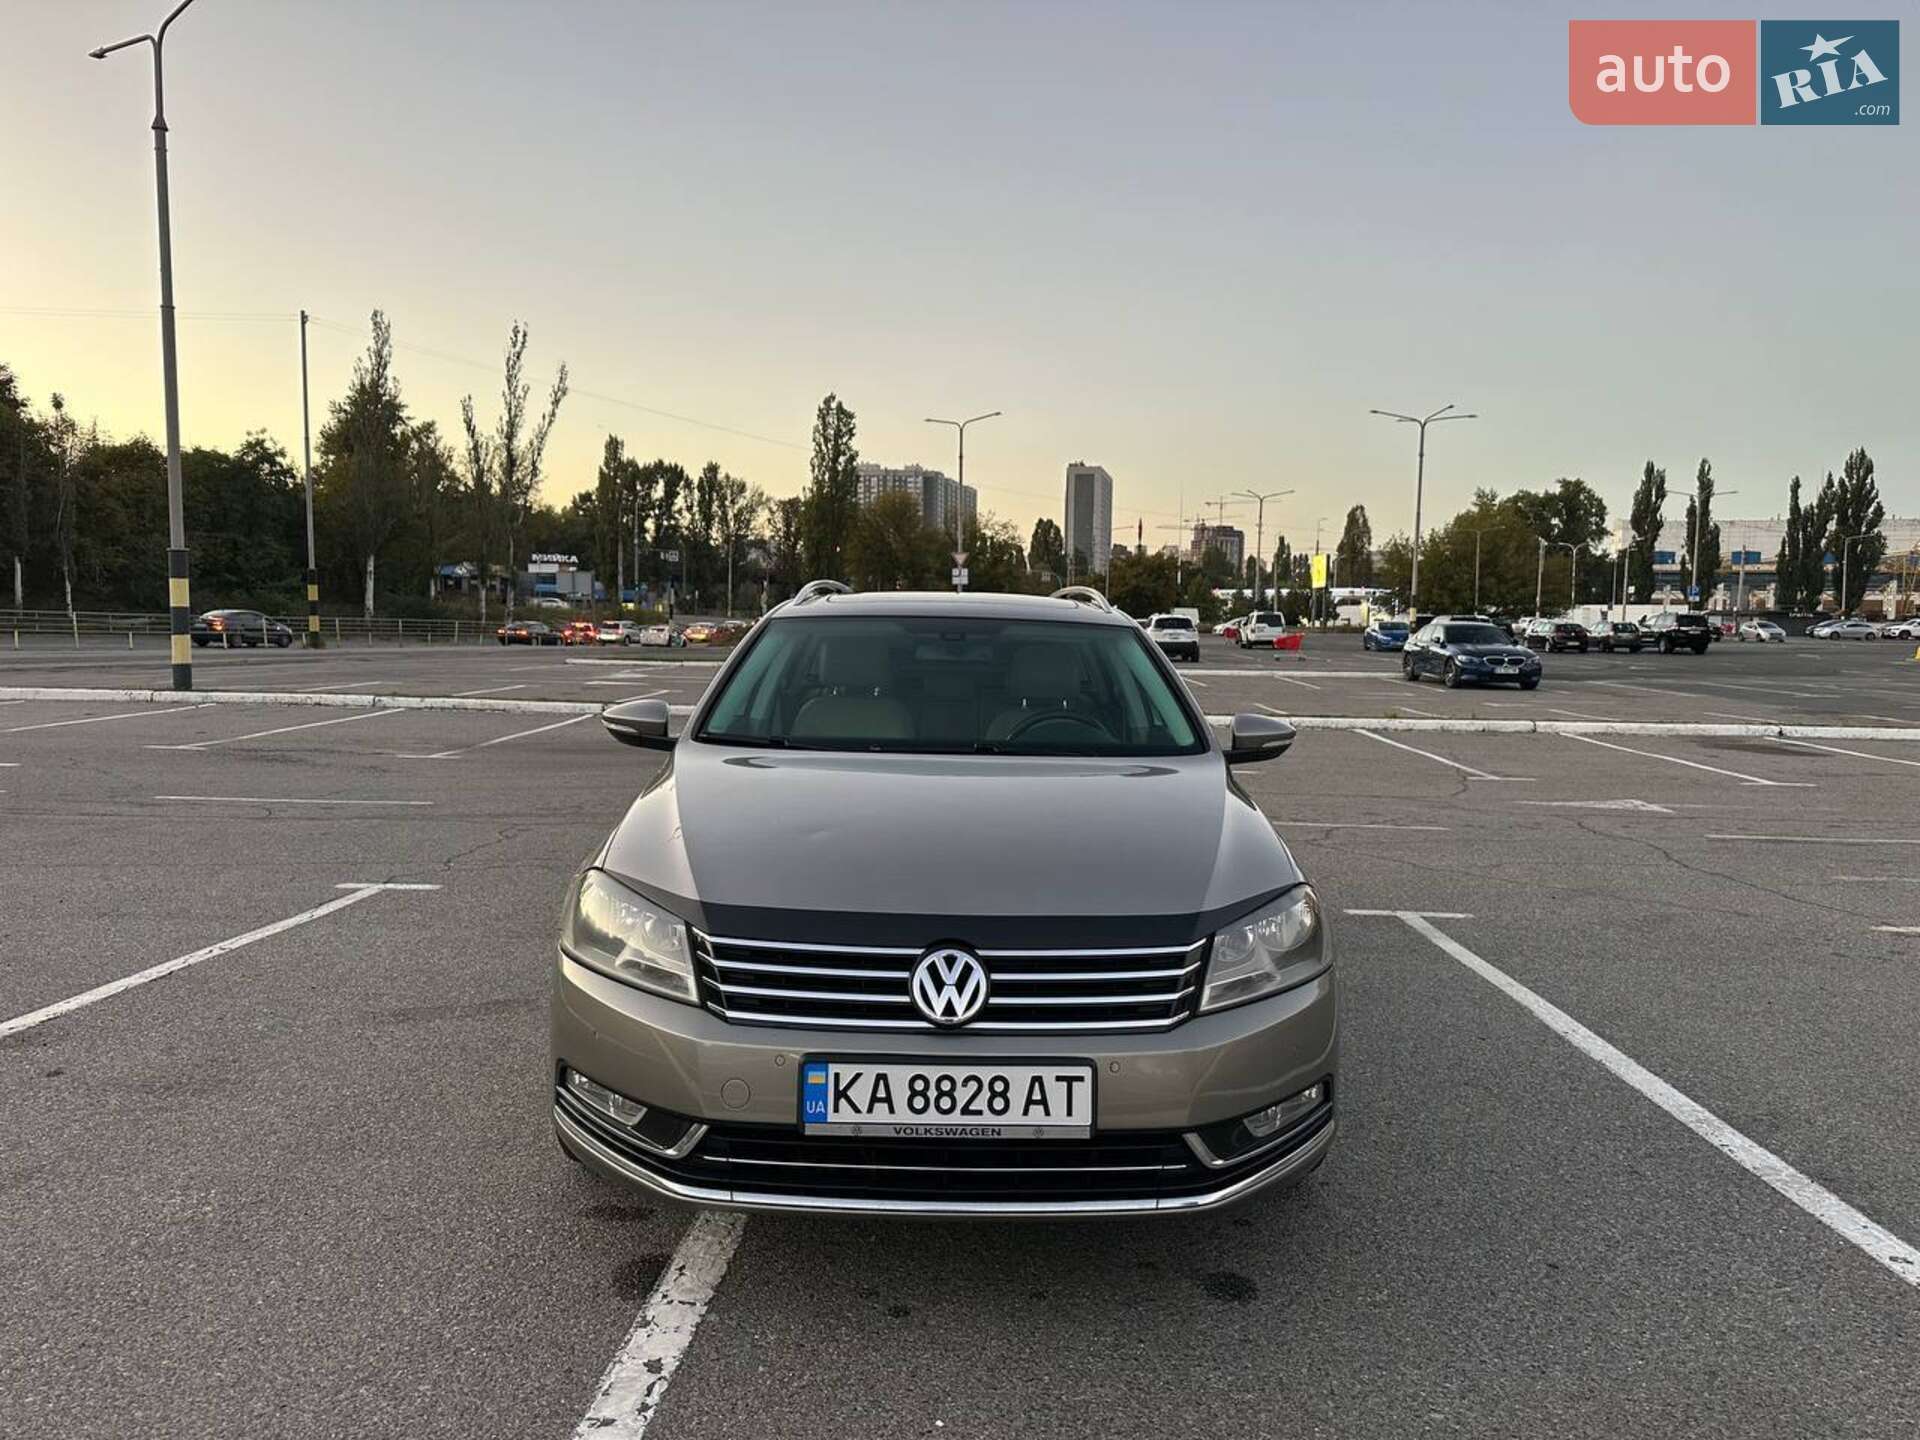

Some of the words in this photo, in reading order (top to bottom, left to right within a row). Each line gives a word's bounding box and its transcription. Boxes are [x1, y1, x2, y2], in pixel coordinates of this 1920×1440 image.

[833, 1071, 896, 1115] KA
[906, 1073, 1010, 1117] 8828
[1021, 1075, 1085, 1117] AT
[806, 1100, 826, 1114] UA
[893, 1126, 1002, 1137] VOLKSWAGEN
